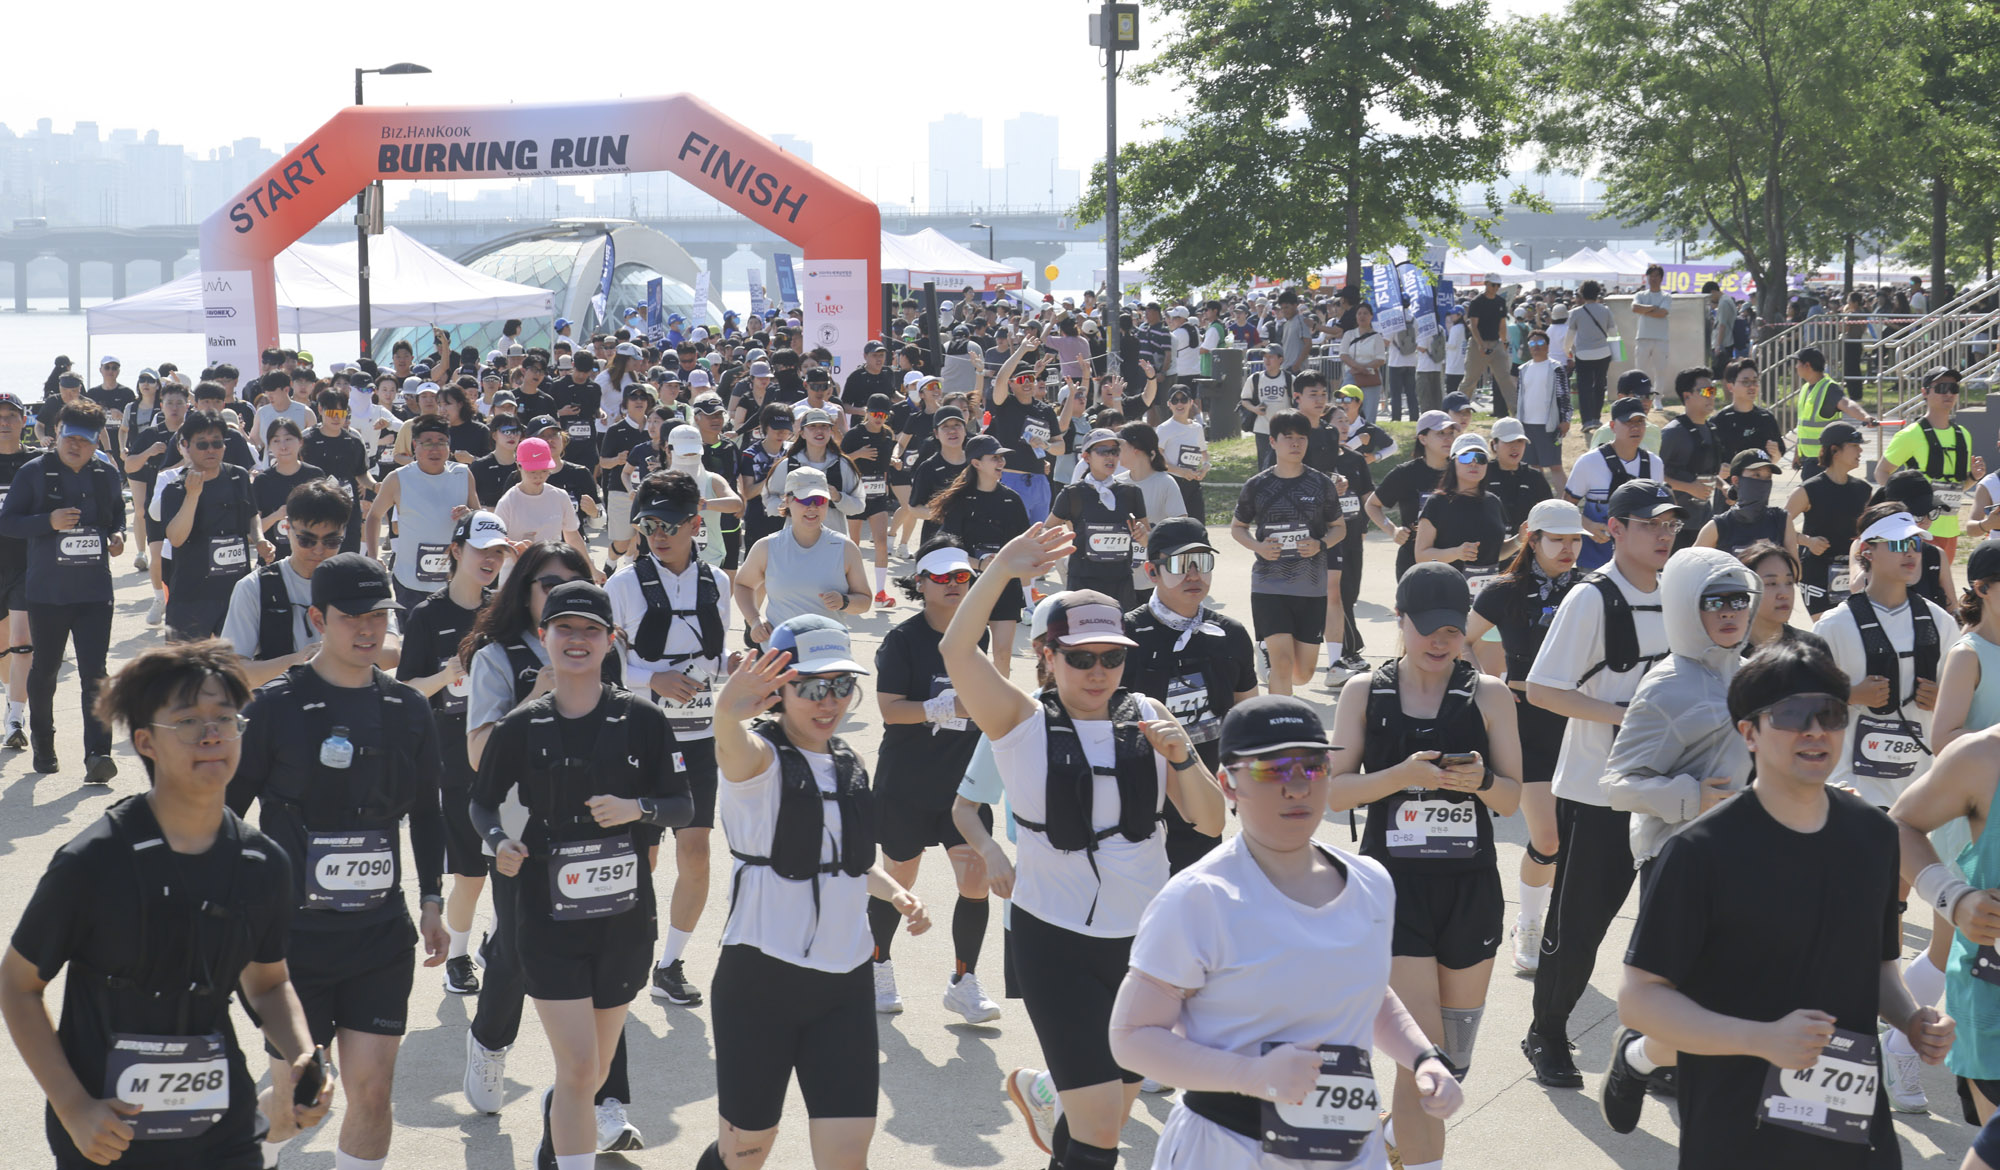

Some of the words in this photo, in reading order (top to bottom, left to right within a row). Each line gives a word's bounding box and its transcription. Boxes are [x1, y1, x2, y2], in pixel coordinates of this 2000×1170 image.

[377, 140, 538, 173] BURNING
[551, 134, 629, 169] RUN
[678, 130, 809, 225] FINISH
[229, 143, 327, 234] START
[1260, 386, 1286, 398] 1989
[66, 541, 74, 549] M
[75, 538, 100, 549] 7230
[1103, 536, 1129, 545] 7711
[1078, 618, 1117, 627] SALOMON
[809, 643, 846, 653] SALOMON
[1268, 716, 1304, 727] KIPRUN
[1868, 740, 1880, 750] W
[1884, 739, 1922, 754] 7889
[1404, 809, 1418, 822] W
[1423, 807, 1474, 823] 7965
[1392, 833, 1415, 843] D-62
[325, 864, 341, 876] M
[346, 858, 392, 877] 7090
[565, 873, 581, 885] W
[585, 861, 636, 884] 7597
[130, 1078, 150, 1093] M
[157, 1069, 224, 1093] 7268
[1820, 1066, 1876, 1097] 7074
[1315, 1085, 1378, 1111] 7984
[1776, 1102, 1815, 1118] B-112
